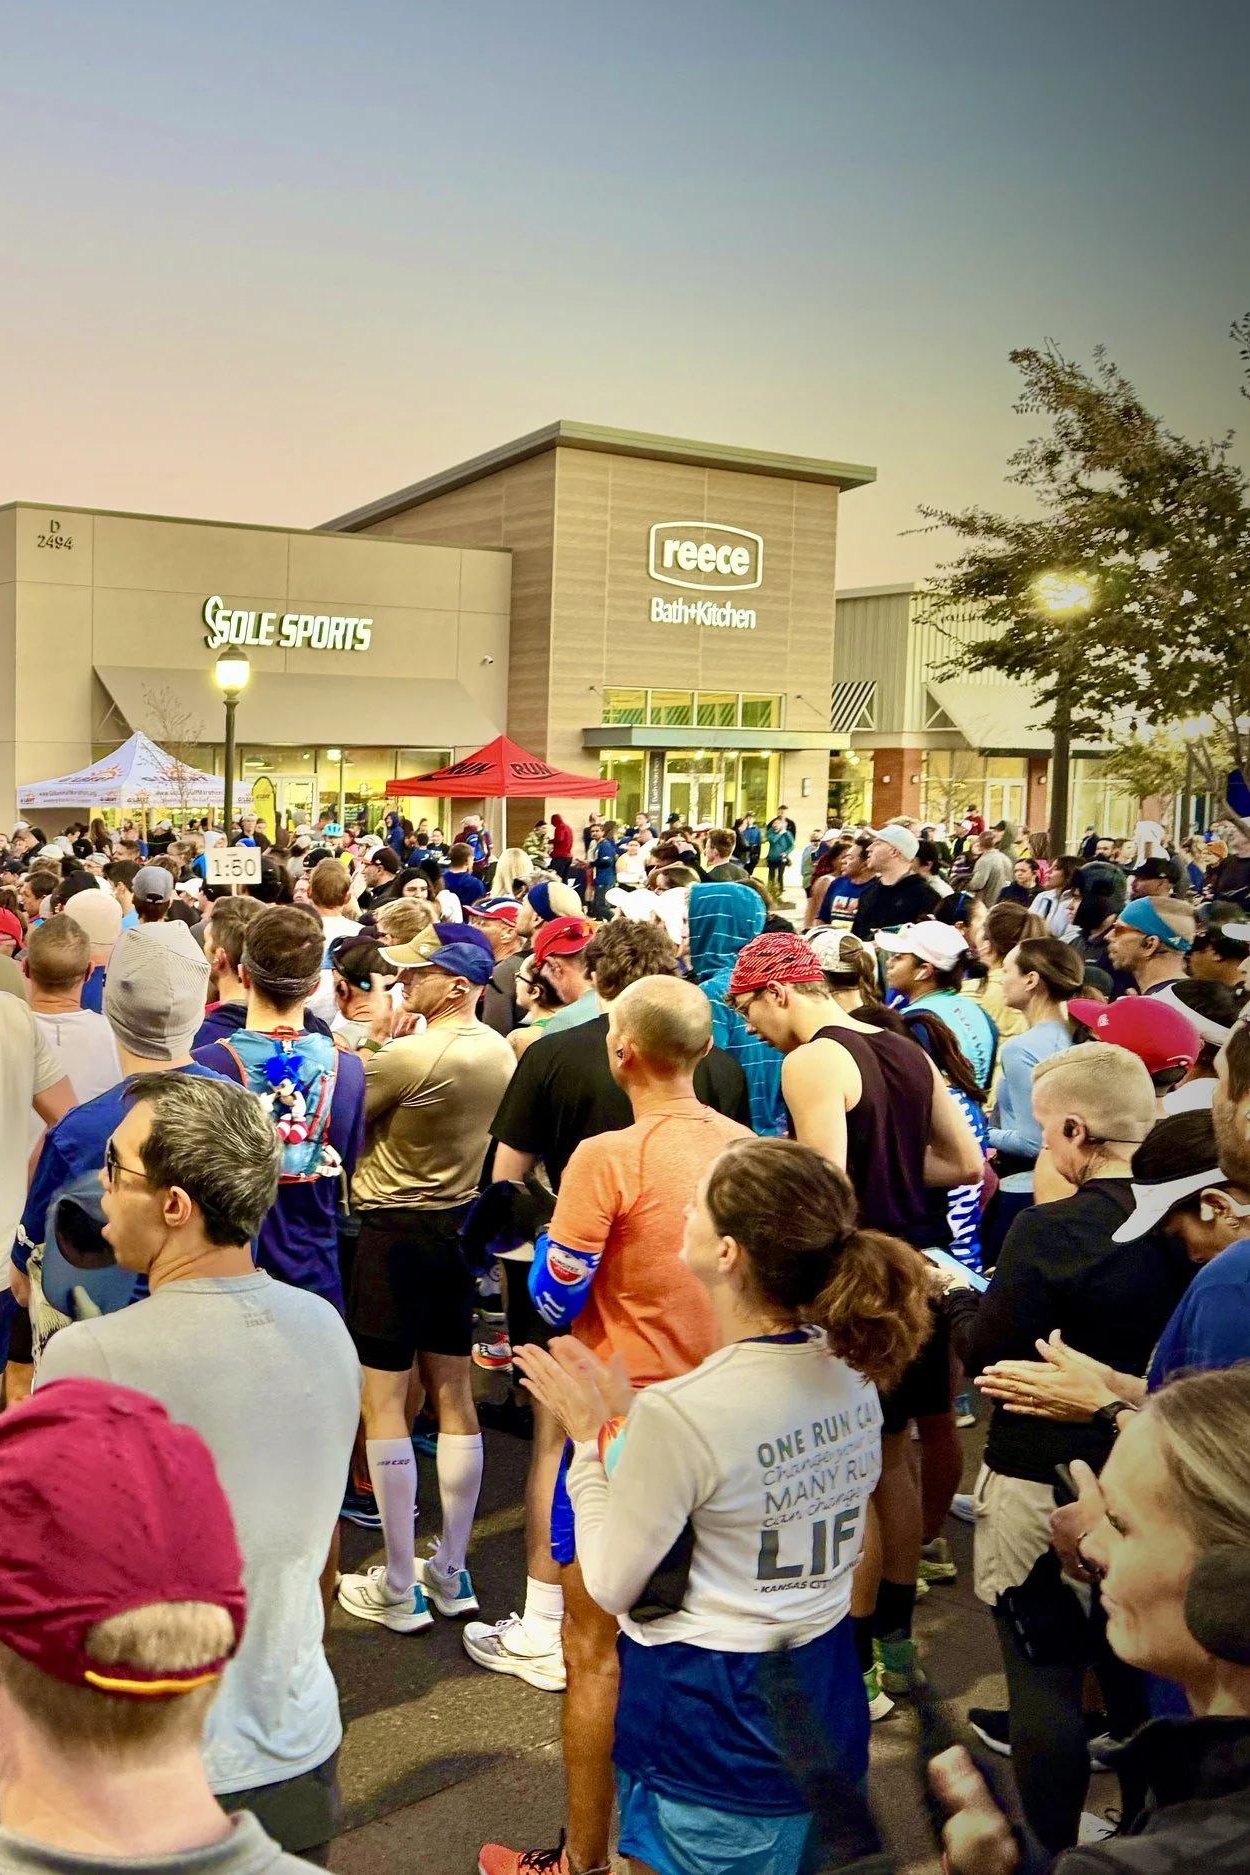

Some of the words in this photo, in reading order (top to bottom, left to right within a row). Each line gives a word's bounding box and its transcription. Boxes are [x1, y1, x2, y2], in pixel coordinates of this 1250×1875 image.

[50, 520, 60, 533] D
[37, 535, 73, 550] 2494
[663, 539, 750, 575] reece
[279, 613, 373, 651] SPORTS
[442, 761, 498, 775] RUN
[510, 762, 553, 776] RUN
[213, 859, 257, 877] 1:50
[757, 1428, 806, 1469] ONE
[812, 1410, 852, 1448] RUN
[764, 1464, 840, 1515] MANY
